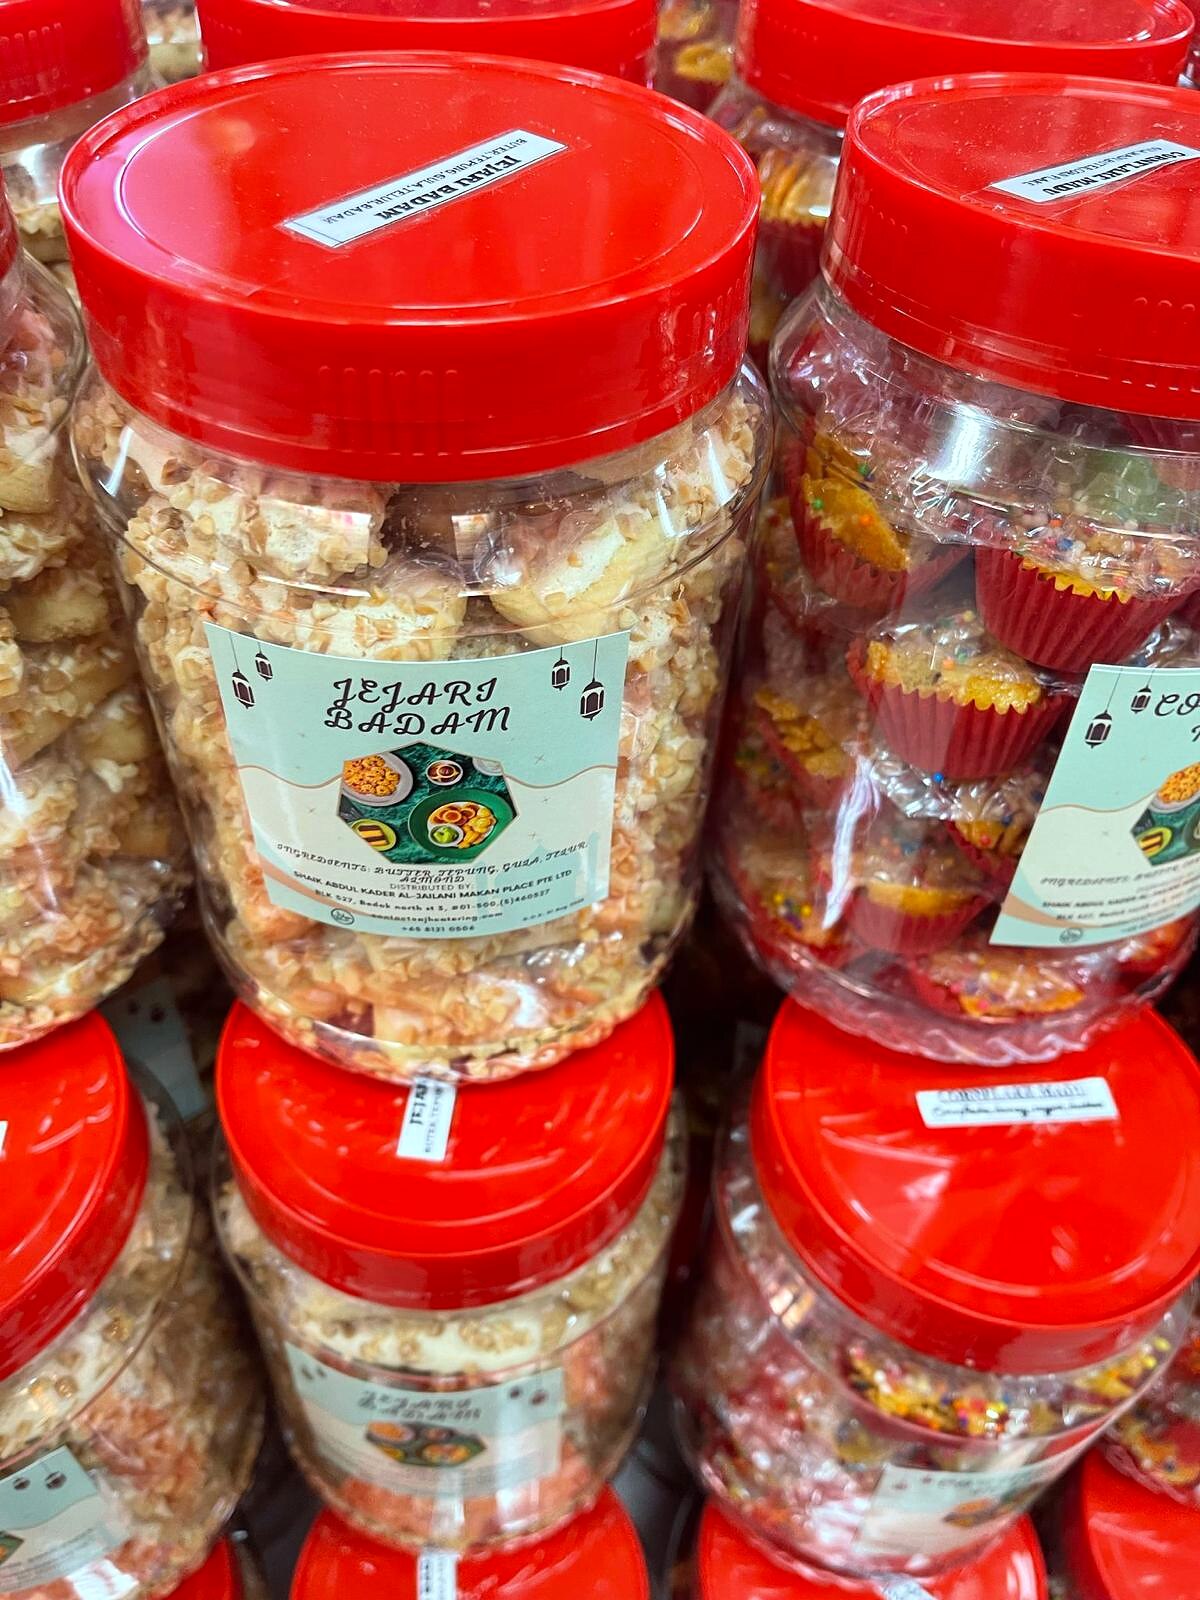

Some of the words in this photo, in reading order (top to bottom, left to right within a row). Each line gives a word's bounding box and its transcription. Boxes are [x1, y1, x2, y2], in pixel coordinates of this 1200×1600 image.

[454, 155, 522, 189] JEJARI
[1092, 151, 1187, 183] CORNFLAKE
[1042, 175, 1099, 197] MADU
[374, 184, 460, 221] BADAM
[333, 677, 497, 714] JEJARI
[324, 706, 510, 735] BADAM
[276, 843, 371, 873] INGREDIENTS:
[293, 870, 322, 886] SHAIK
[325, 880, 358, 894] ABDUL
[361, 888, 396, 898] KADER
[398, 892, 456, 900] AL-JAILANI
[459, 888, 500, 899] MAKAN
[502, 880, 535, 893] PLACE
[536, 876, 553, 886] PTE
[555, 869, 572, 881] LTD
[390, 883, 454, 891] DISTRIBUTED
[360, 900, 391, 909] Bedok
[394, 903, 423, 911] north
